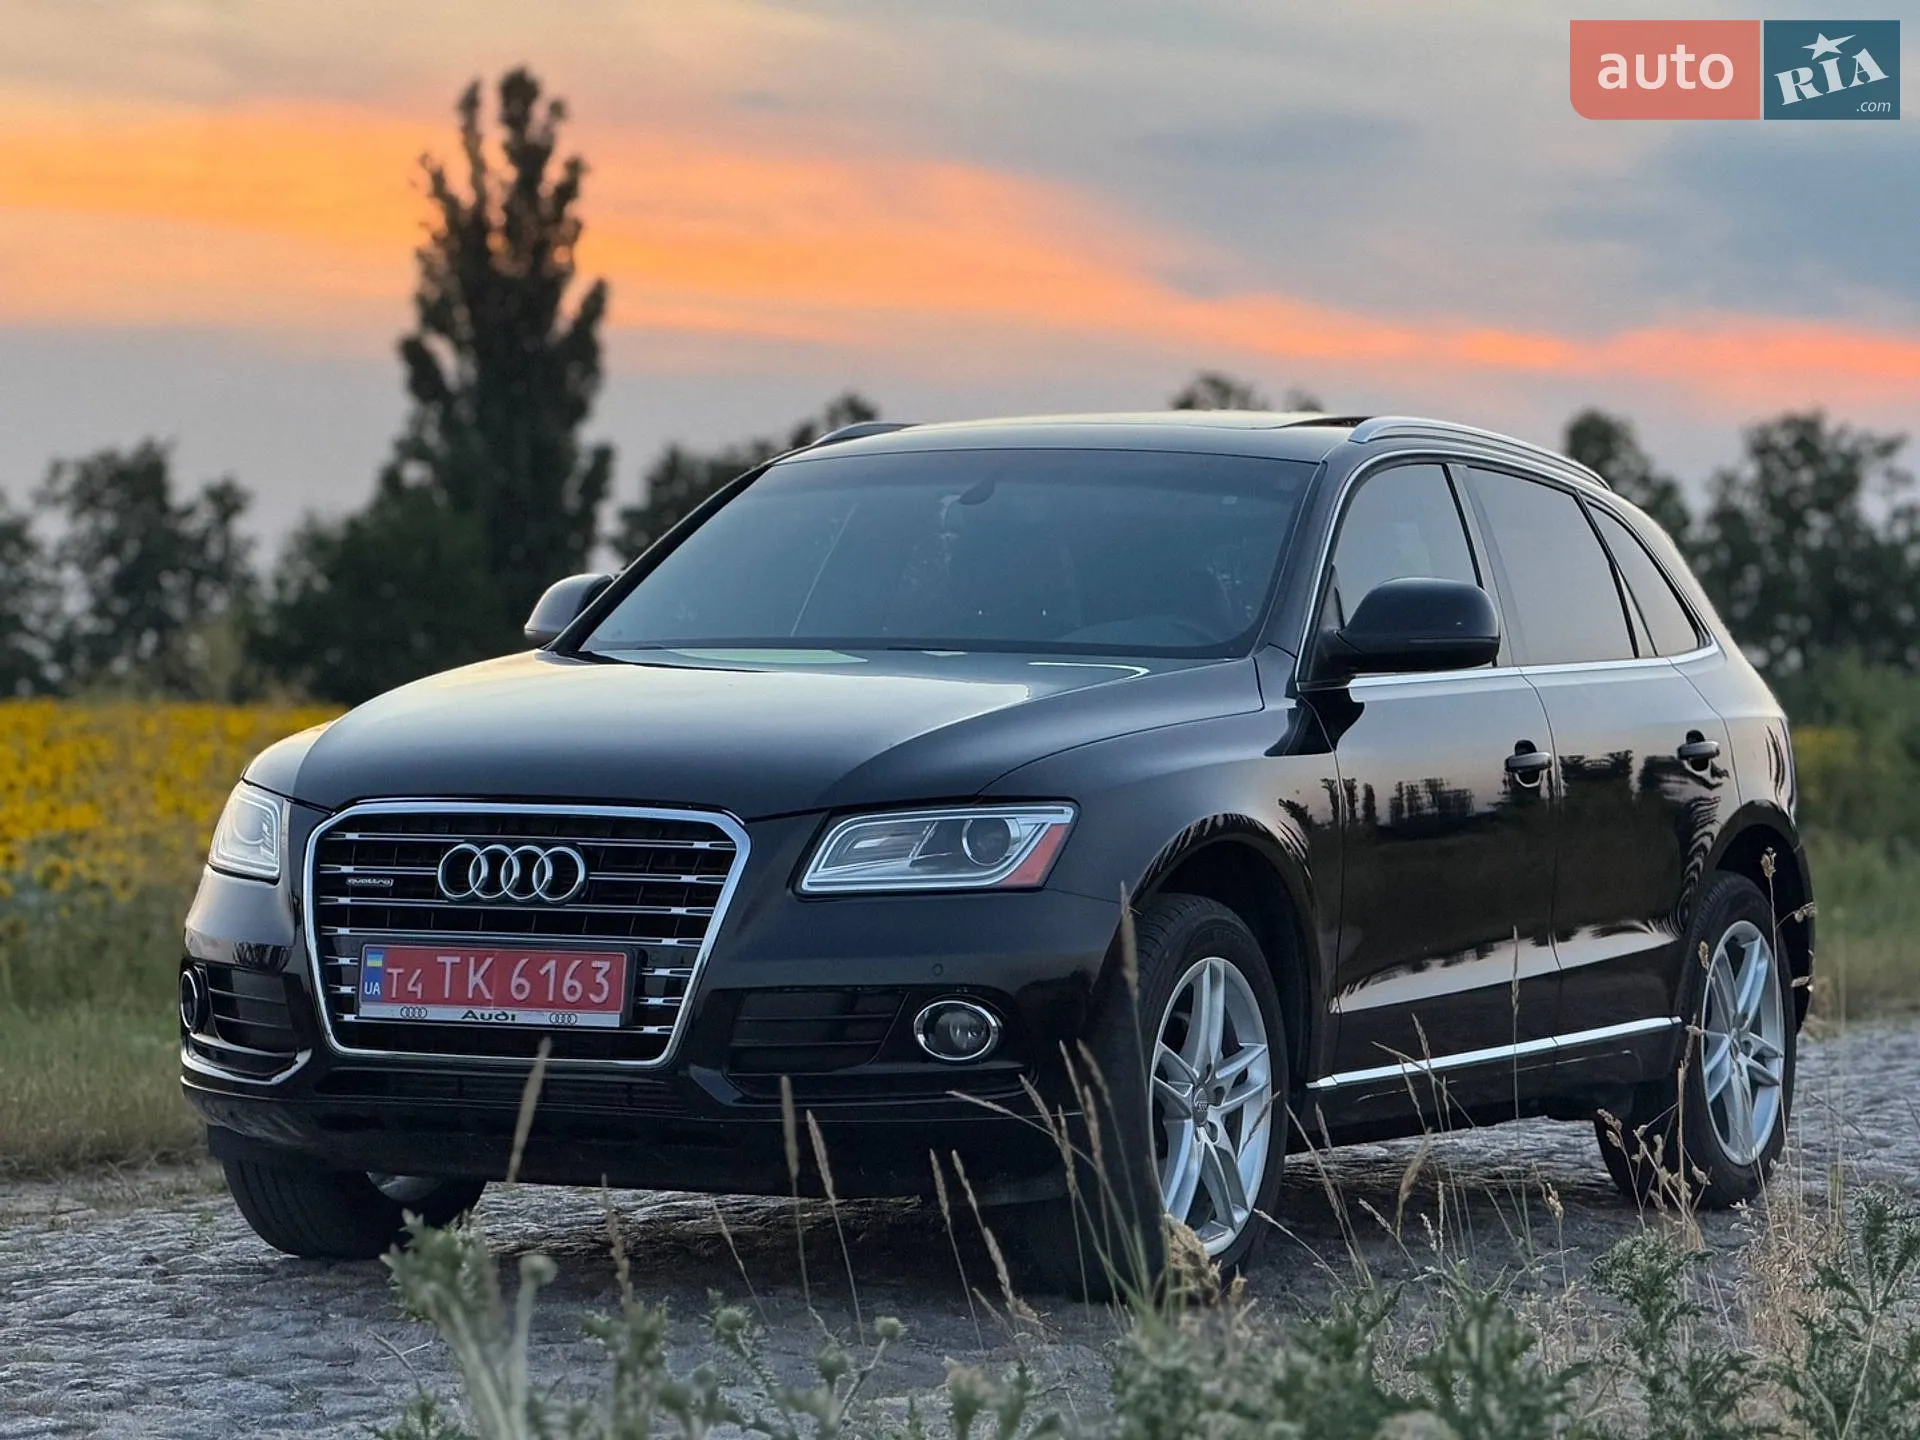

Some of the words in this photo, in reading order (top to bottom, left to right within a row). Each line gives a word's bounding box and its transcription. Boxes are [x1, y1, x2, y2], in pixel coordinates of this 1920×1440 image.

[386, 967, 424, 999] T4
[436, 955, 494, 1000] TK
[510, 957, 611, 1004] 6163
[364, 981, 381, 996] UA
[460, 1009, 516, 1022] Audi
